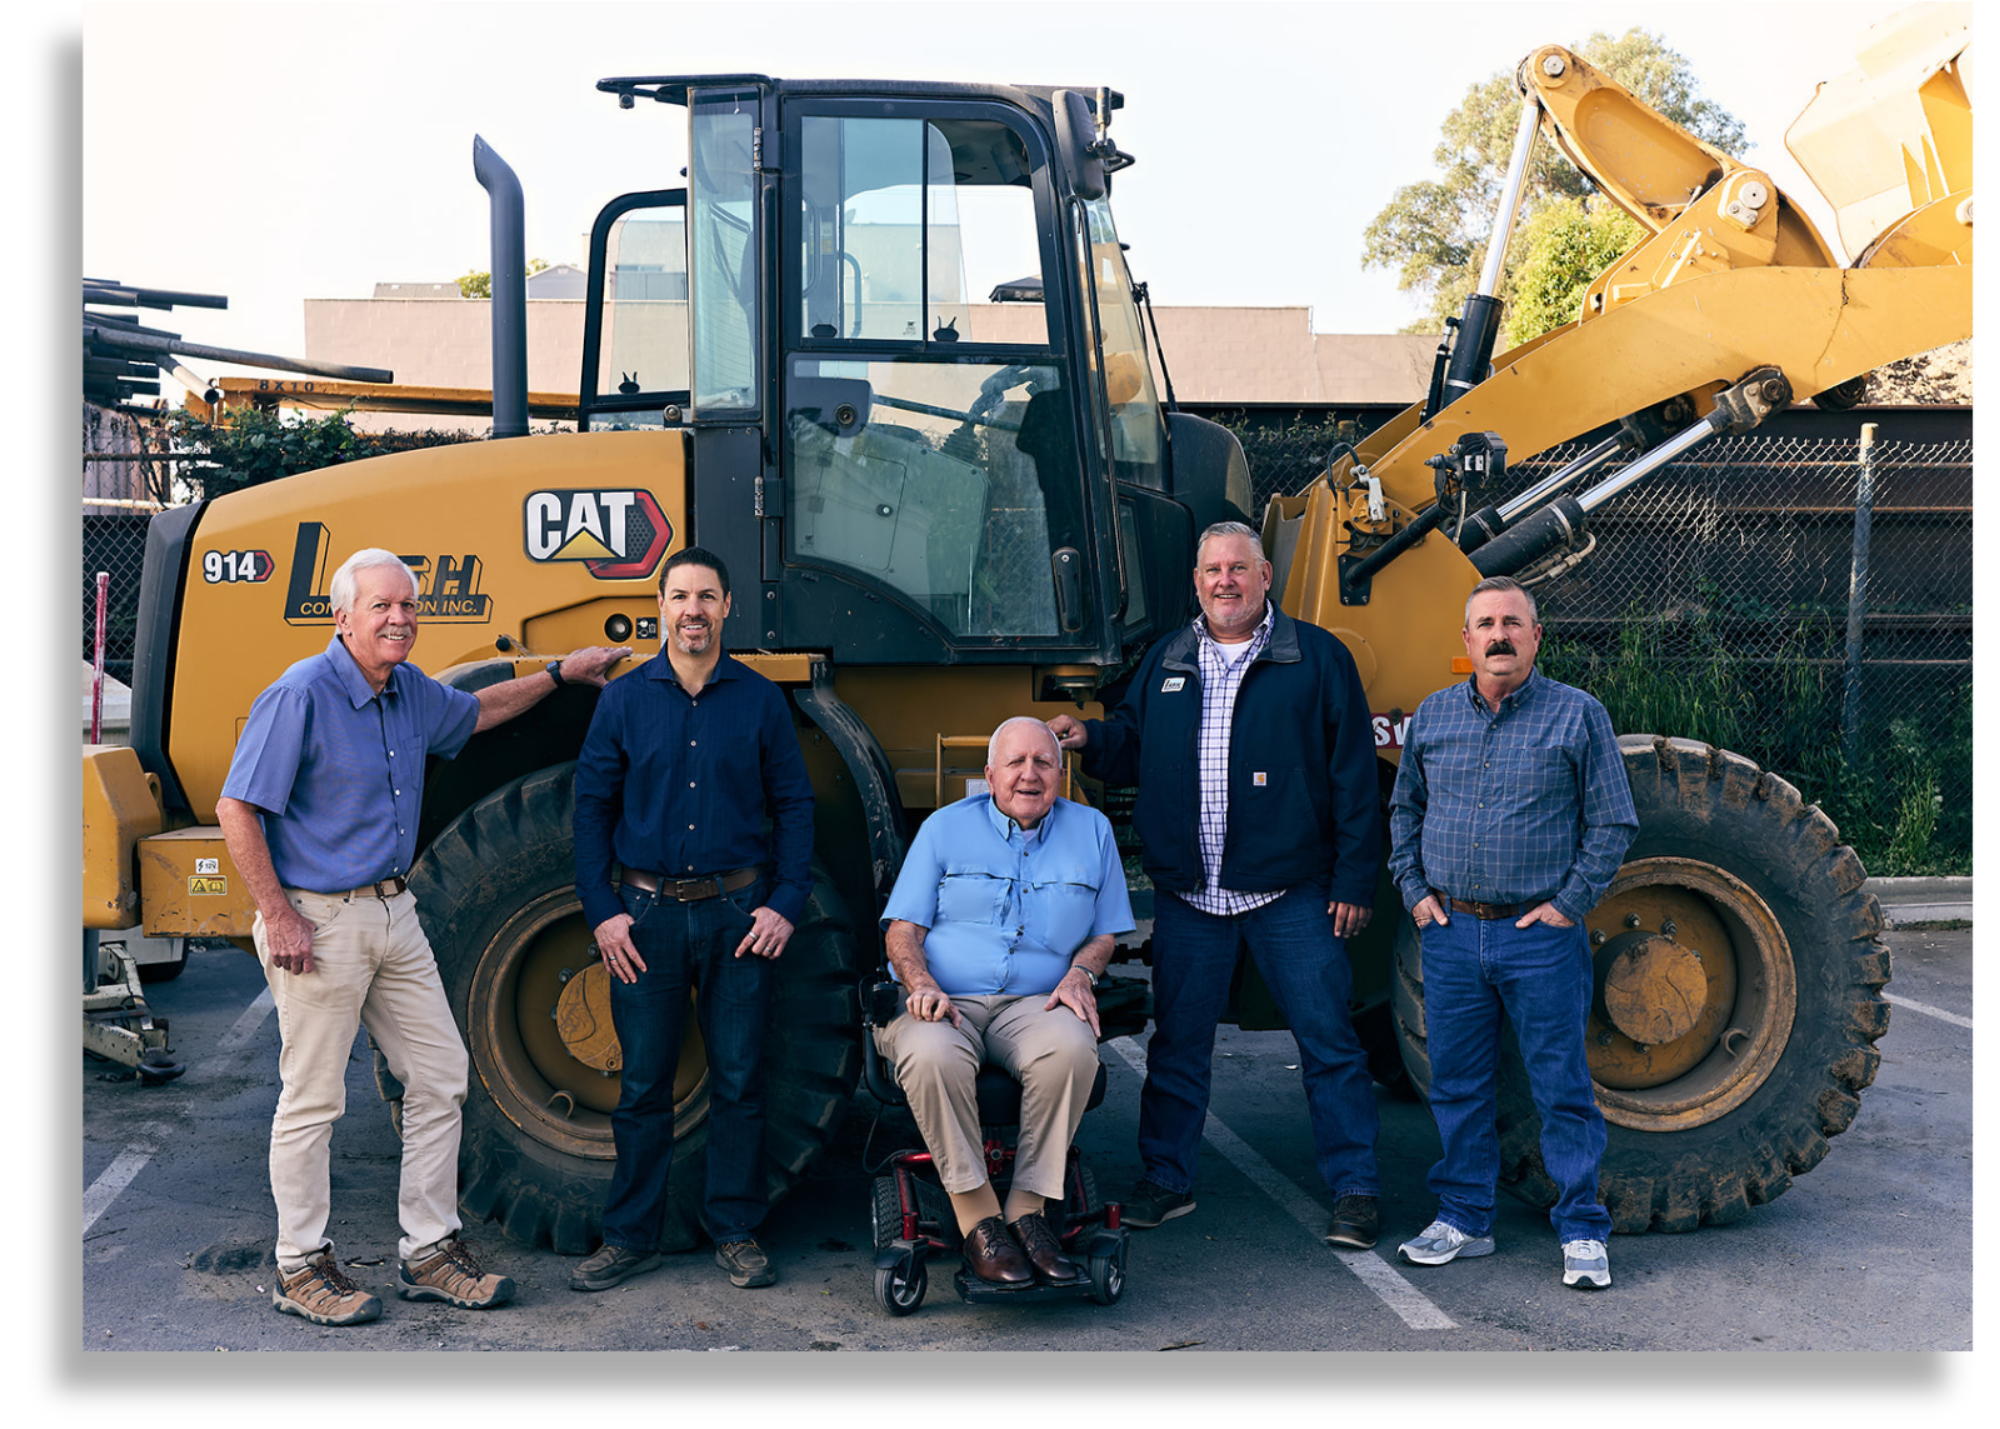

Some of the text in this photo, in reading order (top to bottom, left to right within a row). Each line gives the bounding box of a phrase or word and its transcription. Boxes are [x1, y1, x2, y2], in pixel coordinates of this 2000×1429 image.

[526, 491, 635, 560] CAT
[204, 551, 257, 583] 914
[284, 521, 493, 626] LH
[442, 599, 478, 614] INC.
